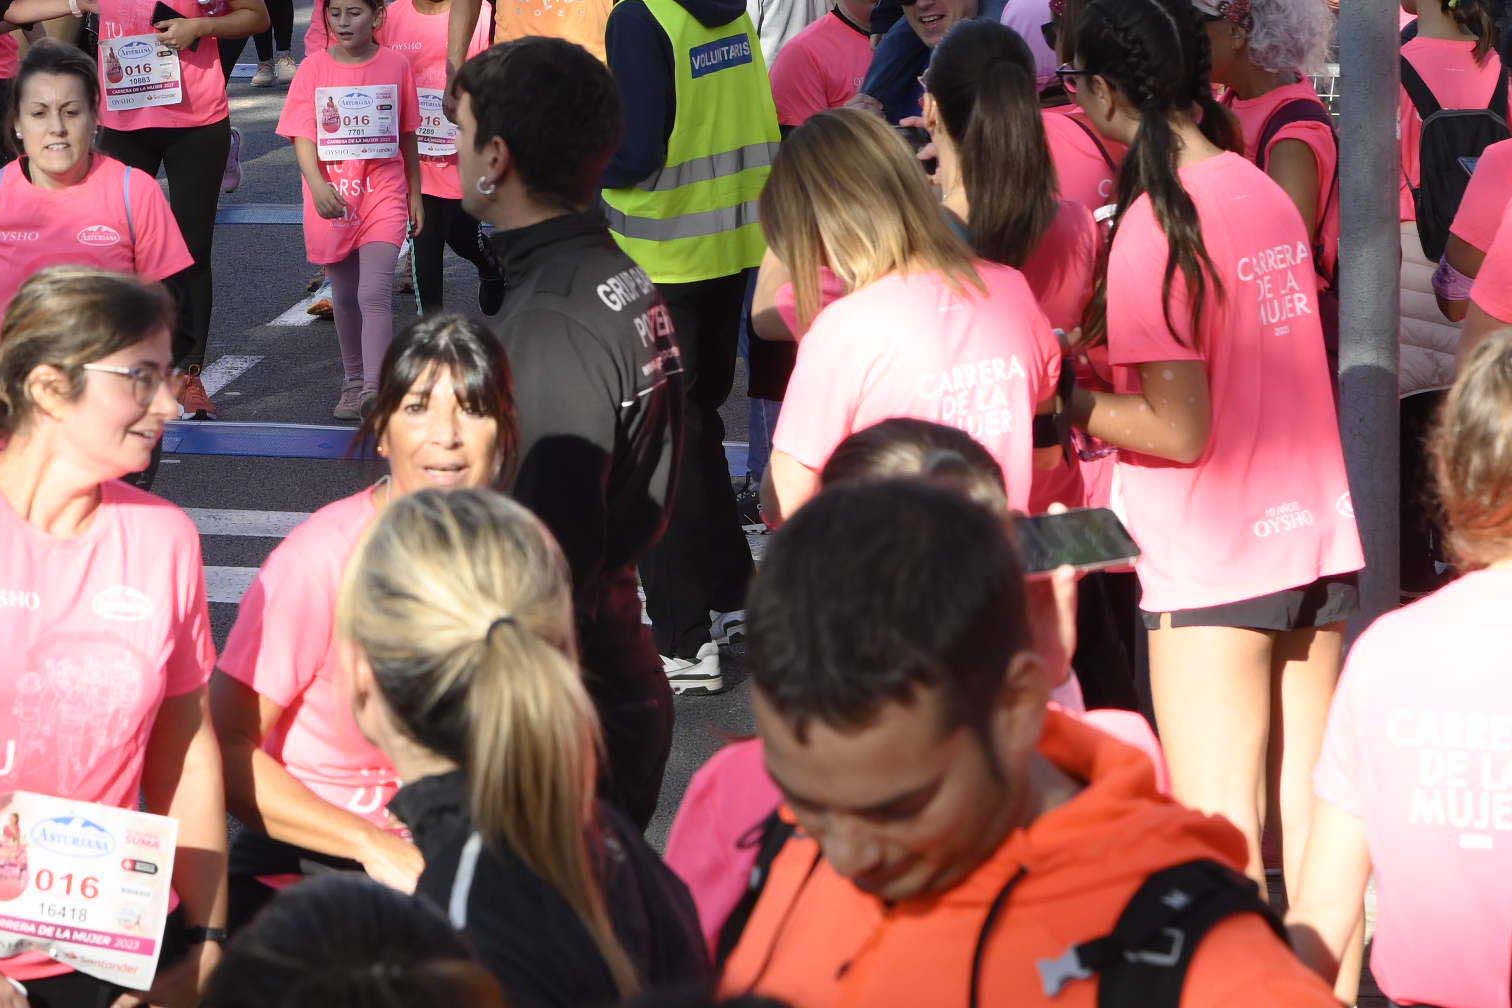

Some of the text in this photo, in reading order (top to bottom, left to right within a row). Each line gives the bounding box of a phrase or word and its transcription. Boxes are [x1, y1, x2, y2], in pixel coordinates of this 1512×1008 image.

[104, 21, 124, 39] TU
[124, 63, 152, 77] 016
[692, 42, 750, 70] VOLUNTARIS
[343, 115, 370, 126] 016
[1237, 241, 1309, 283] CARRERA
[919, 353, 1026, 399] CARRERA
[941, 386, 1008, 421] DE LA
[1253, 509, 1313, 538] OYSHO
[1419, 750, 1468, 788] DE
[39, 827, 109, 853] ASTURIANA
[34, 868, 101, 900] 016
[38, 902, 88, 922] 16418
[38, 924, 54, 938] DE
[56, 926, 71, 939] LA
[71, 929, 113, 947] MUJER
